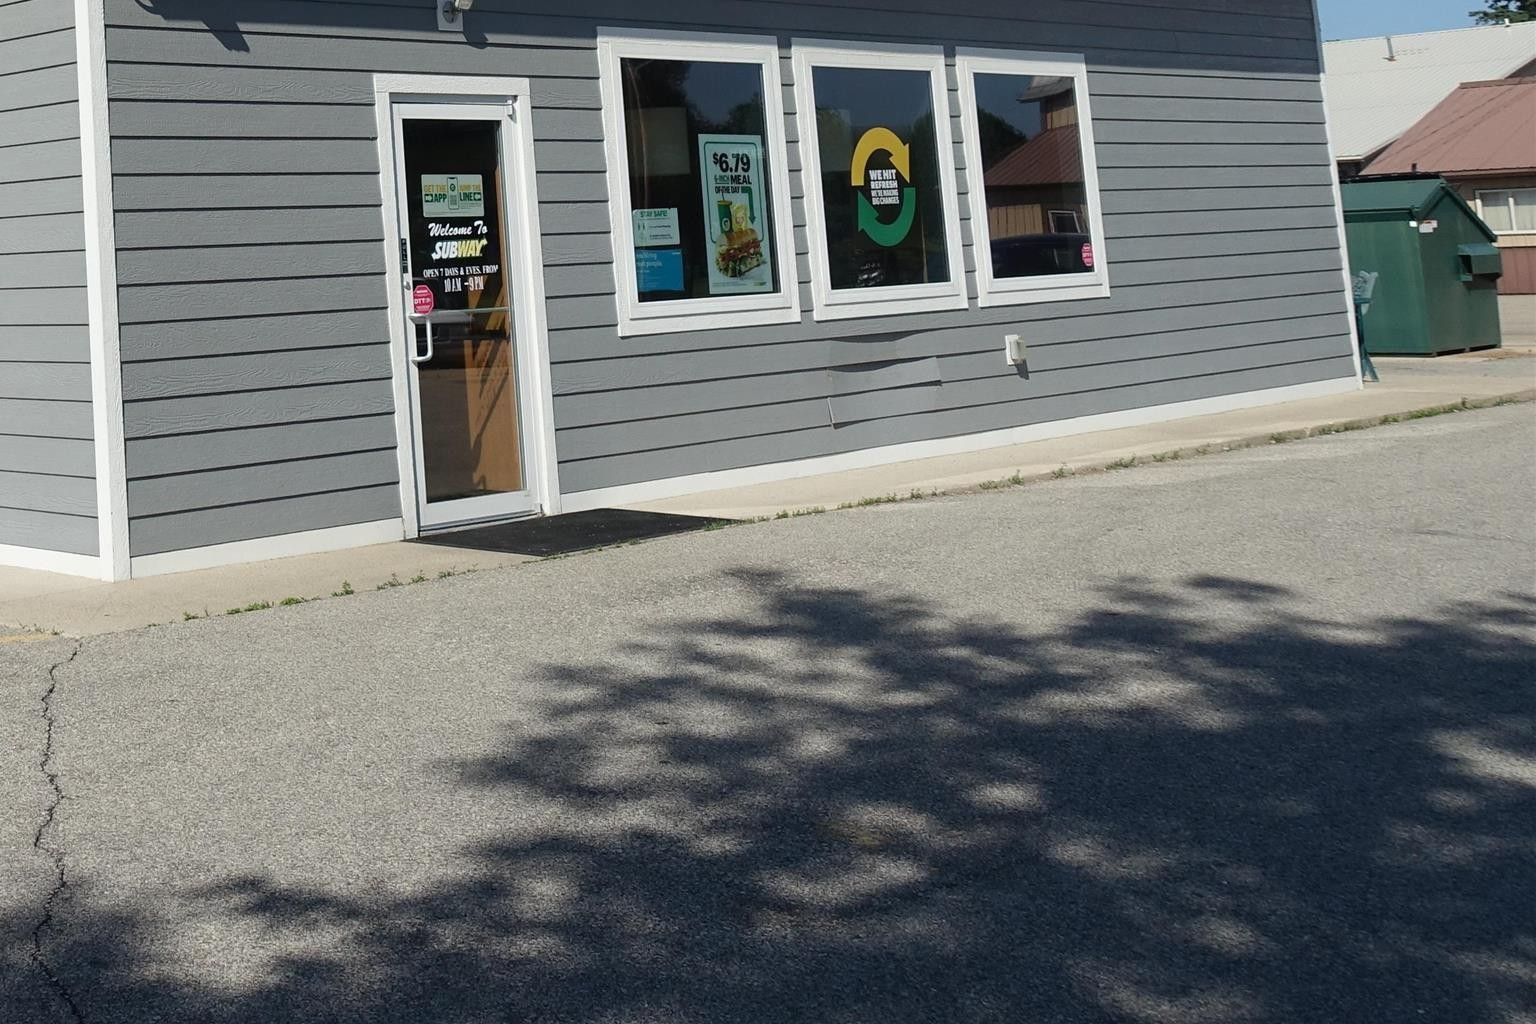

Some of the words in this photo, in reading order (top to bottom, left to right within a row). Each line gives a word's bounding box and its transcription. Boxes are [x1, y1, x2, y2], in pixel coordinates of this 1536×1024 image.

[712, 152, 751, 173] $6.79
[730, 174, 752, 185] MEAL
[869, 169, 882, 181] WE
[883, 169, 896, 180] HIT
[870, 180, 898, 189] REFRESH
[433, 193, 448, 203] APP
[459, 192, 472, 202] LINE
[427, 222, 473, 237] Welcome
[473, 220, 488, 235] To
[431, 238, 488, 261] SUBWAY
[423, 269, 440, 278] OPEN
[444, 267, 459, 277] DAYS
[459, 266, 465, 276] &
[482, 264, 499, 274] FROM
